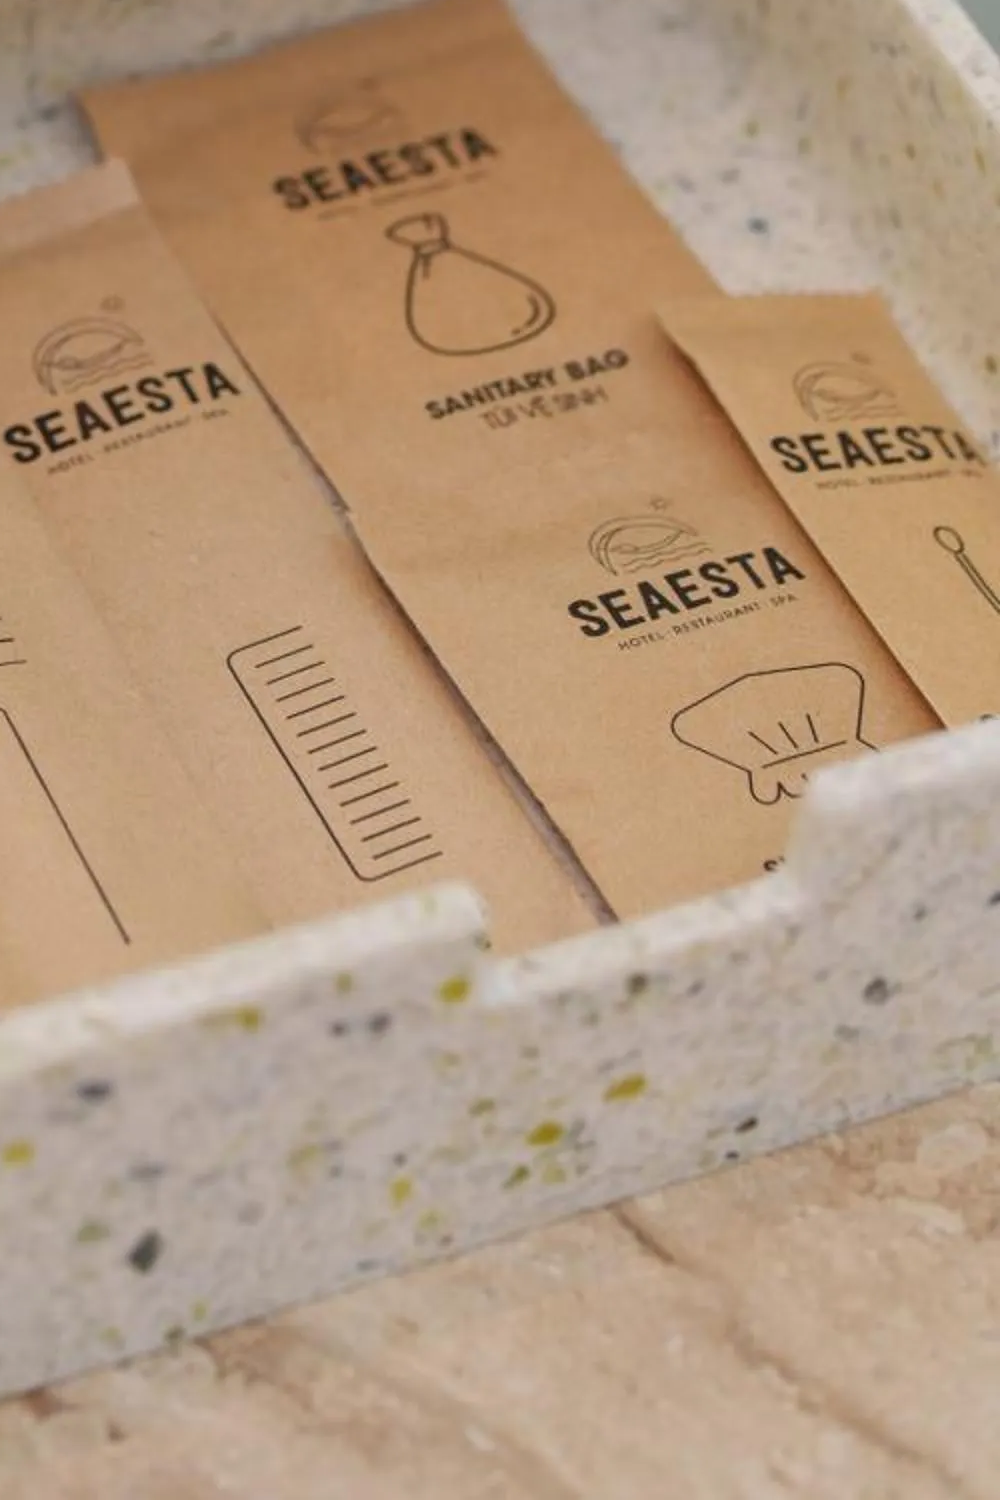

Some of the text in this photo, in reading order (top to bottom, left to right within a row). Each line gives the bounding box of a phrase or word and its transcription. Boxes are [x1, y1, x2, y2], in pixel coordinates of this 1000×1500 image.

[272, 127, 498, 211] SEAESTA
[3, 362, 240, 464] SEAESTA
[424, 348, 629, 420] SANITARY BAG
[770, 425, 988, 473] SEAESTA
[567, 547, 806, 637] SEAESTA
[617, 593, 797, 652] HOTEL RESTAURANT SPA
